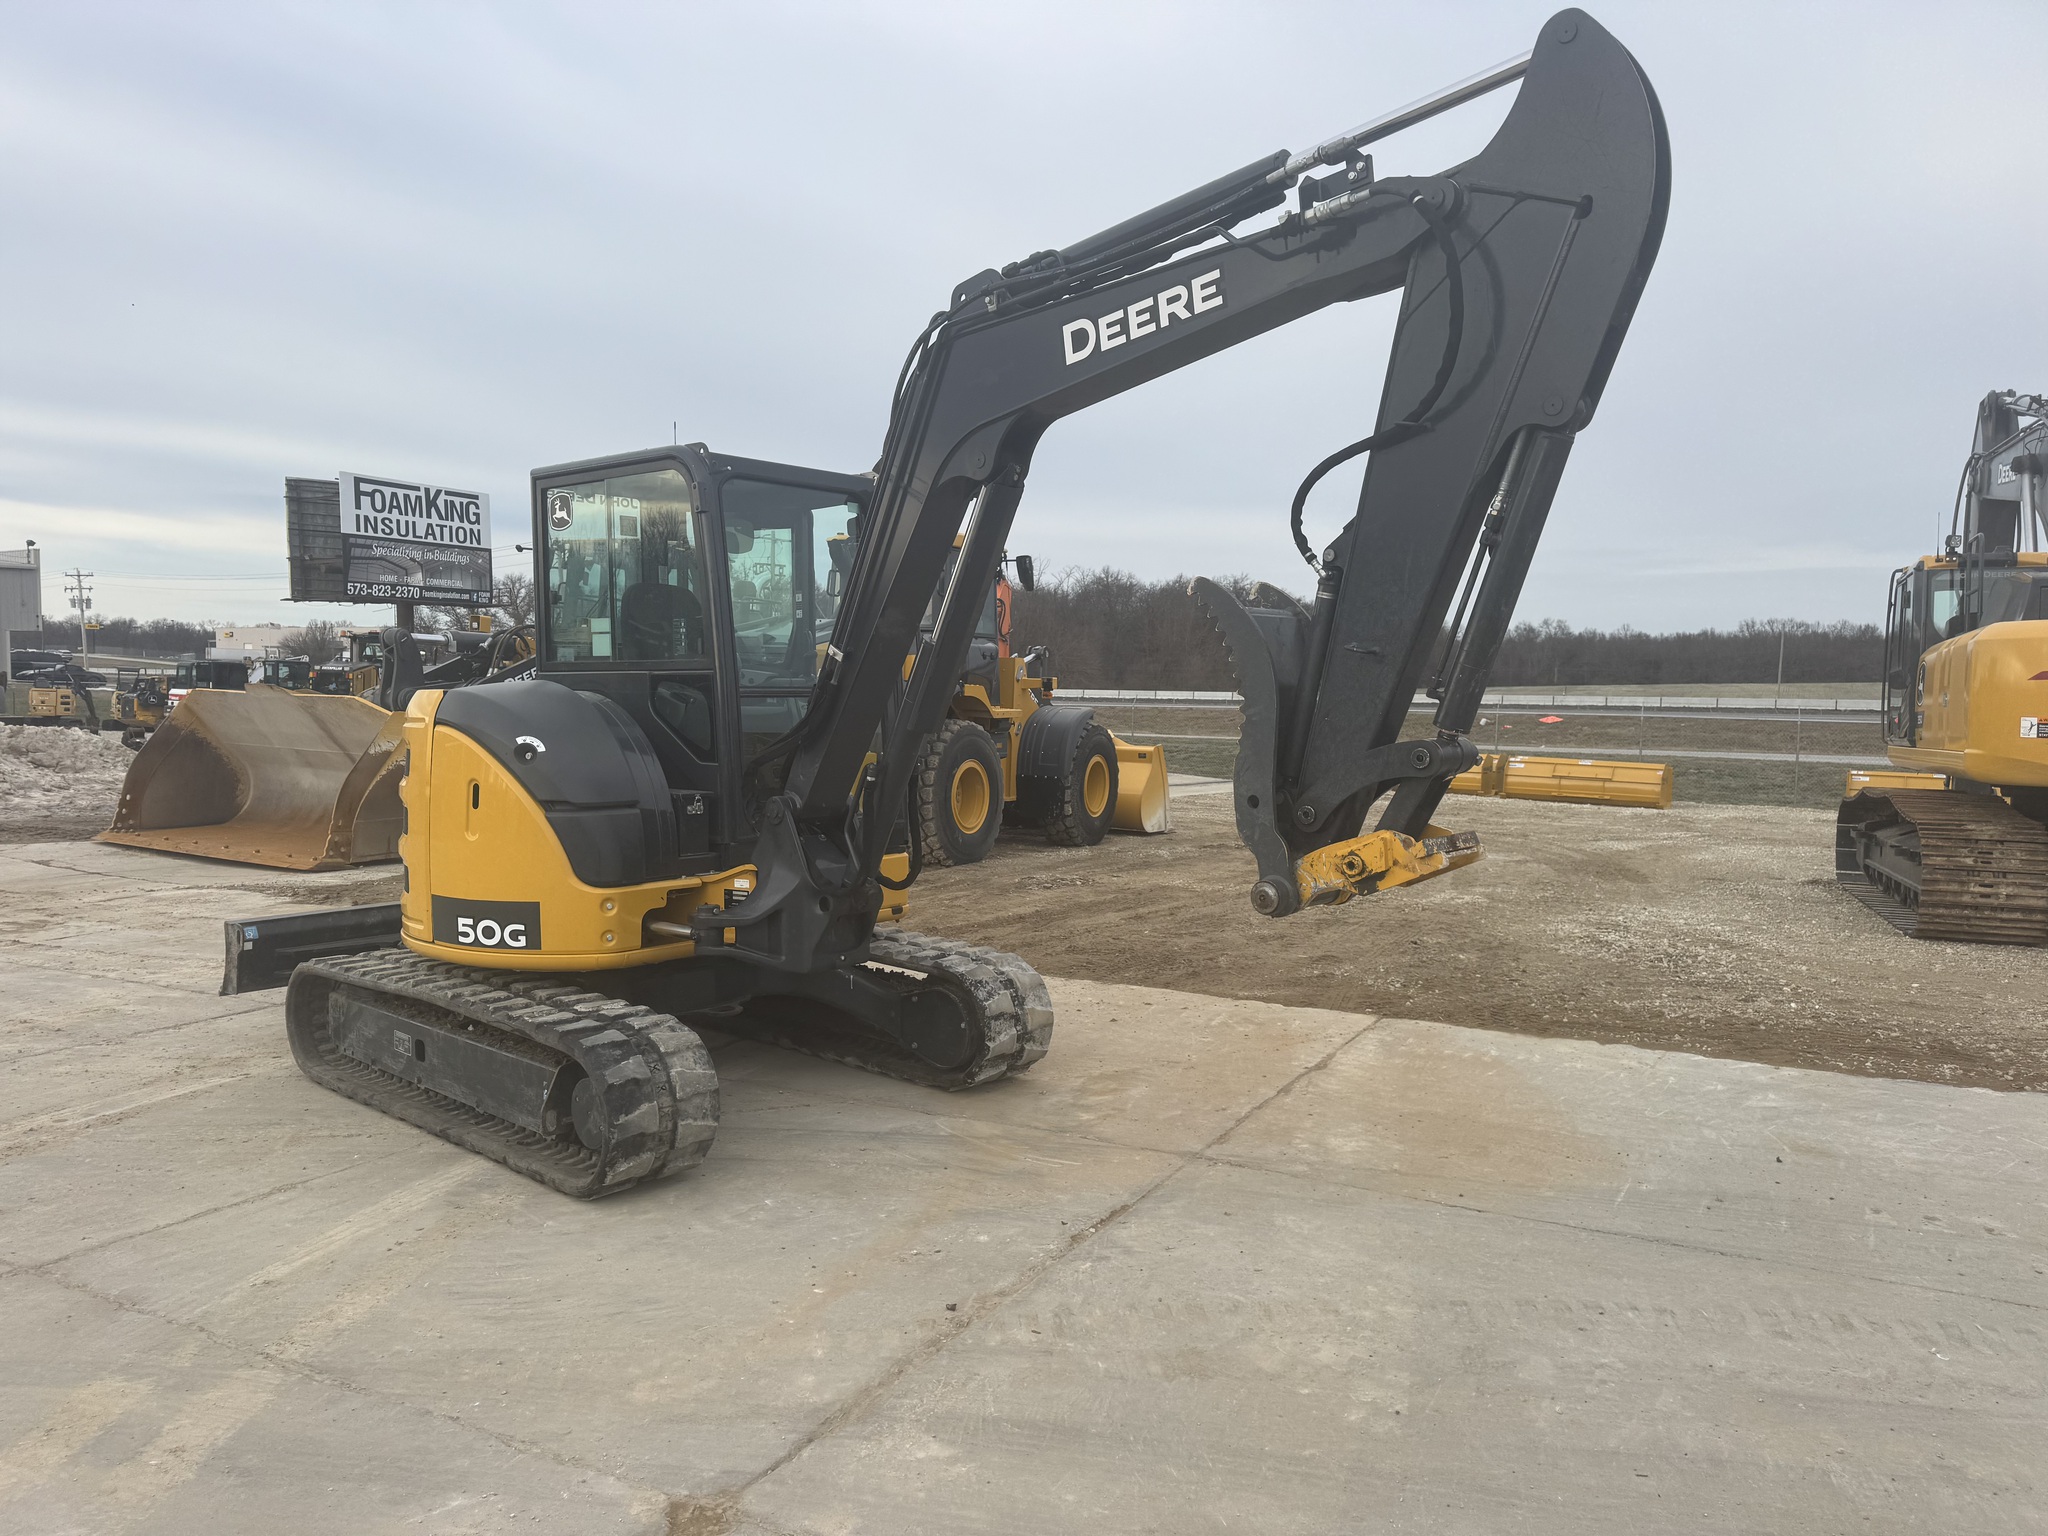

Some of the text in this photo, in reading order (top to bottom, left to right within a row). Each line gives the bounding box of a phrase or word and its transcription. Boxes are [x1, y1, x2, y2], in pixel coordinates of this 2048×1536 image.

[1062, 269, 1223, 365] DEERE
[355, 513, 482, 546] INSULATION
[371, 543, 470, 565] Specializing in Buildings
[347, 582, 420, 599] 573-823-2370
[379, 574, 398, 583] HOME
[403, 576, 420, 585] FARM
[426, 577, 464, 588] COMMERCIAL
[457, 917, 526, 947] 50G
